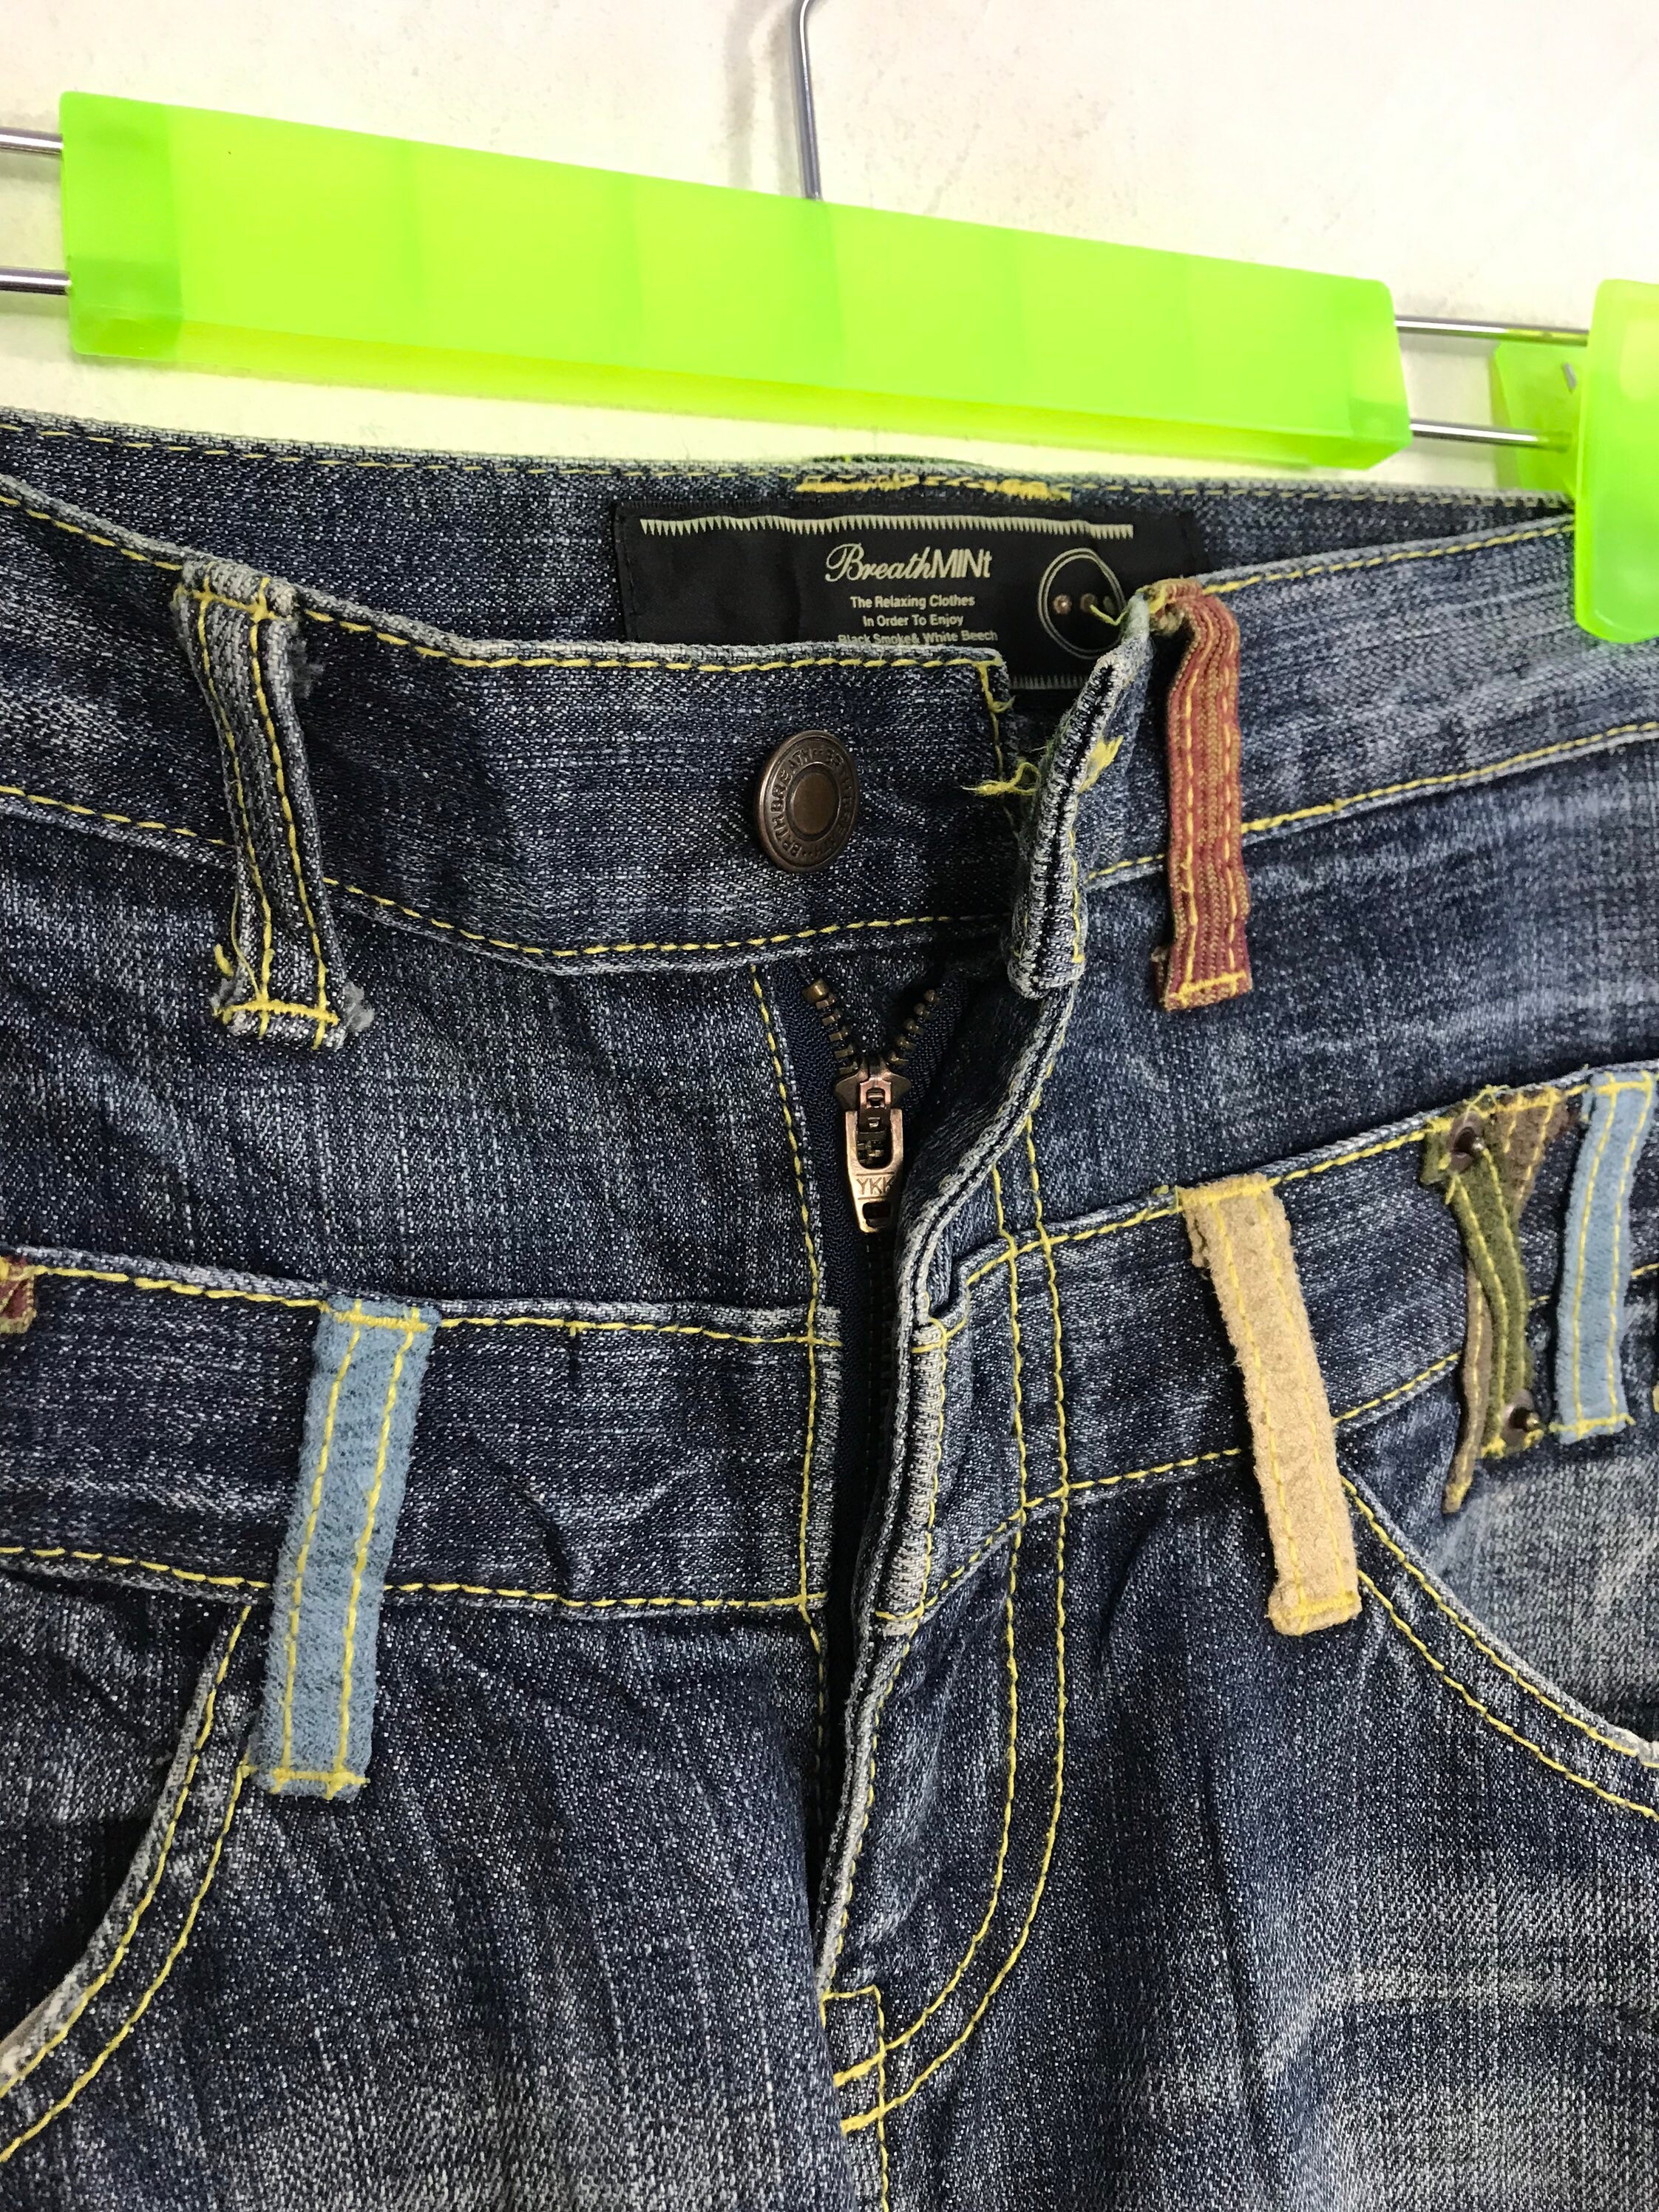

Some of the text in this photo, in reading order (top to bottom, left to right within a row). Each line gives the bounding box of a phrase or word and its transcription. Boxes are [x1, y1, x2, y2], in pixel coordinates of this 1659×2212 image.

[850, 594, 976, 610] The Relaxing Clothes
[863, 613, 964, 627] In Order To Enjoy
[838, 634, 871, 645] Black
[924, 631, 959, 645] White
[961, 630, 998, 642] Beech
[856, 1175, 895, 1195] YKK
